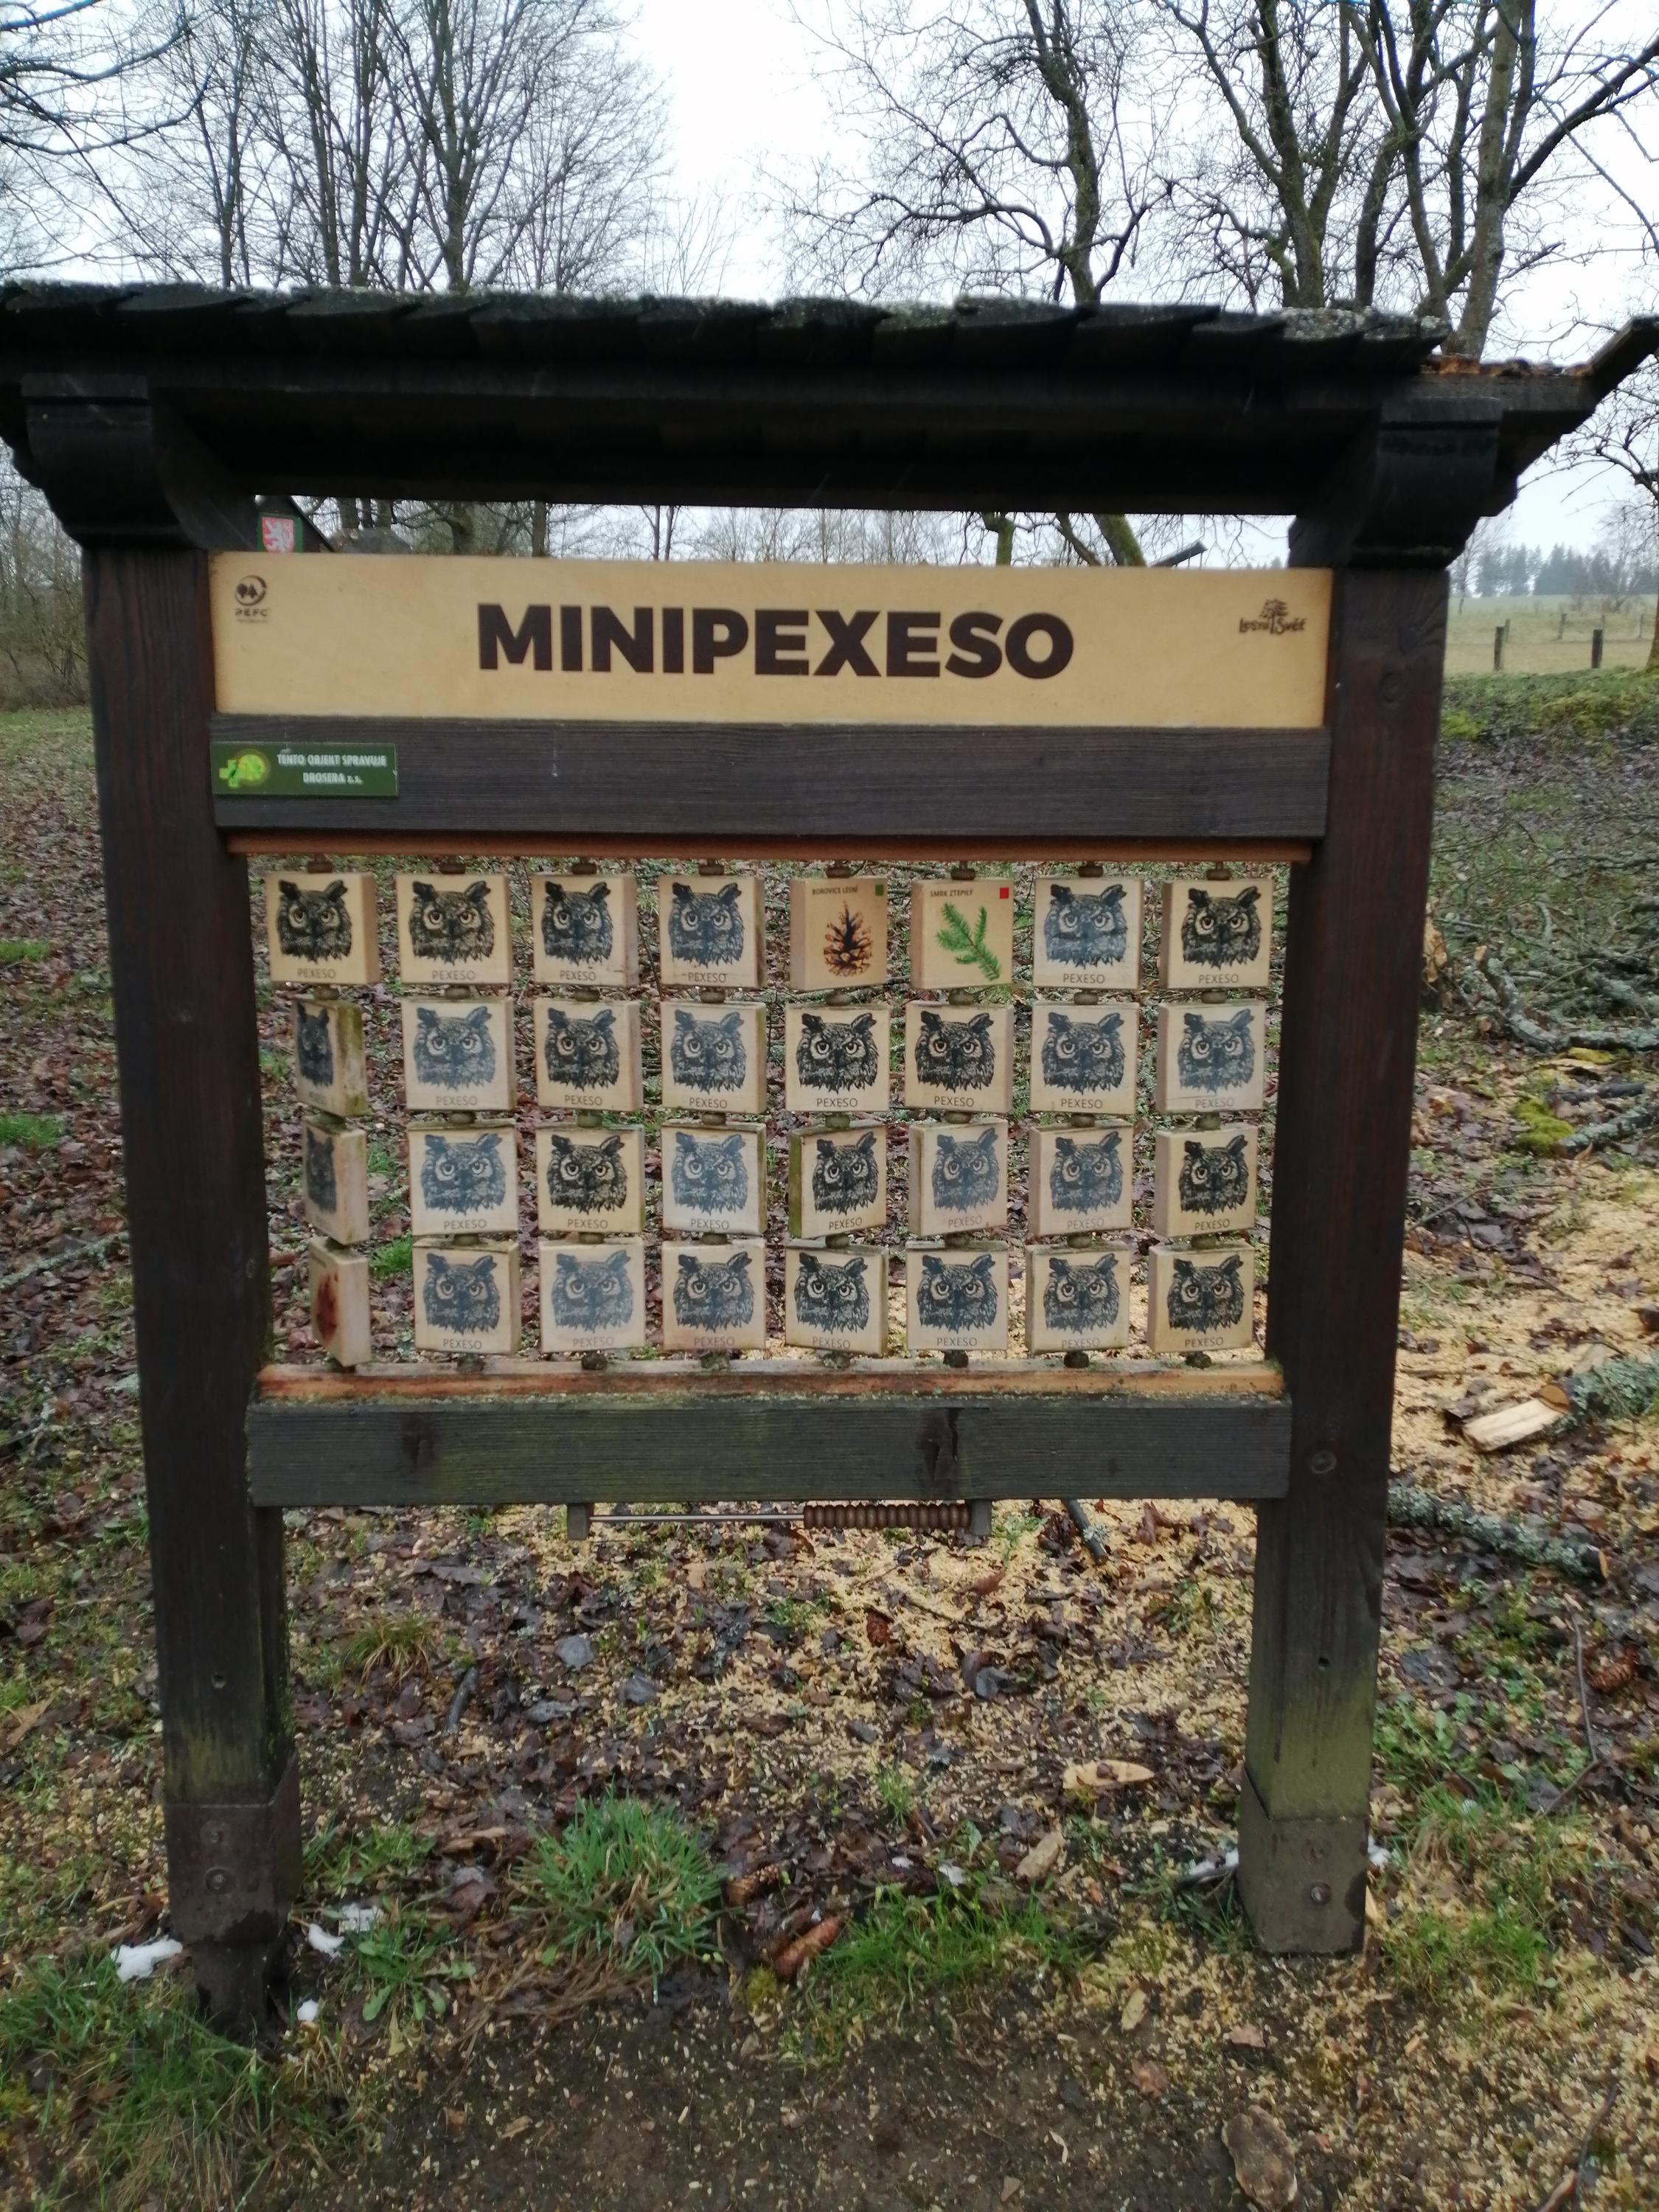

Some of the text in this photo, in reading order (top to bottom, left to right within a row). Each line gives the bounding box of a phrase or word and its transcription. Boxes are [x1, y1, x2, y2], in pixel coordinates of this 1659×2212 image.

[235, 608, 268, 616] PEFC
[477, 604, 1074, 679] MINIPEXESO
[277, 754, 387, 767] TENTO OBJEKT SPRAVUJE
[302, 772, 346, 785] DROSERA
[812, 887, 841, 895] BOROVICE
[930, 889, 947, 897] SMRK
[297, 968, 335, 978] PEXESO
[432, 970, 476, 980] PEXESO
[560, 970, 596, 981] PEXESO
[689, 973, 726, 983] PEXESO
[1063, 973, 1105, 984] PEXESO
[1198, 973, 1239, 984] PEXESO
[436, 1095, 477, 1106] PEXESO
[564, 1095, 602, 1106] PEXESO
[689, 1097, 727, 1108] PEXESO
[816, 1097, 858, 1107] PEXESO
[934, 1096, 974, 1107] PEXESO
[1061, 1099, 1102, 1109] PEXESO
[1194, 1097, 1234, 1108] PEXESO
[444, 1219, 486, 1230] PEXESO
[568, 1219, 608, 1229] PEXESO
[691, 1219, 728, 1229] PEXESO
[829, 1217, 862, 1230] PEXESO
[948, 1215, 982, 1228] PEXESO
[1068, 1217, 1104, 1229] PEXESO
[1194, 1218, 1230, 1231] PEXESO
[443, 1339, 481, 1349] PEXESO
[573, 1337, 613, 1347] PEXESO
[695, 1337, 734, 1348] PEXESO
[813, 1337, 851, 1349] PEXESO
[937, 1337, 977, 1346] PEXESO
[1062, 1338, 1100, 1349] PEXESO
[1185, 1338, 1223, 1348] PEXESO
